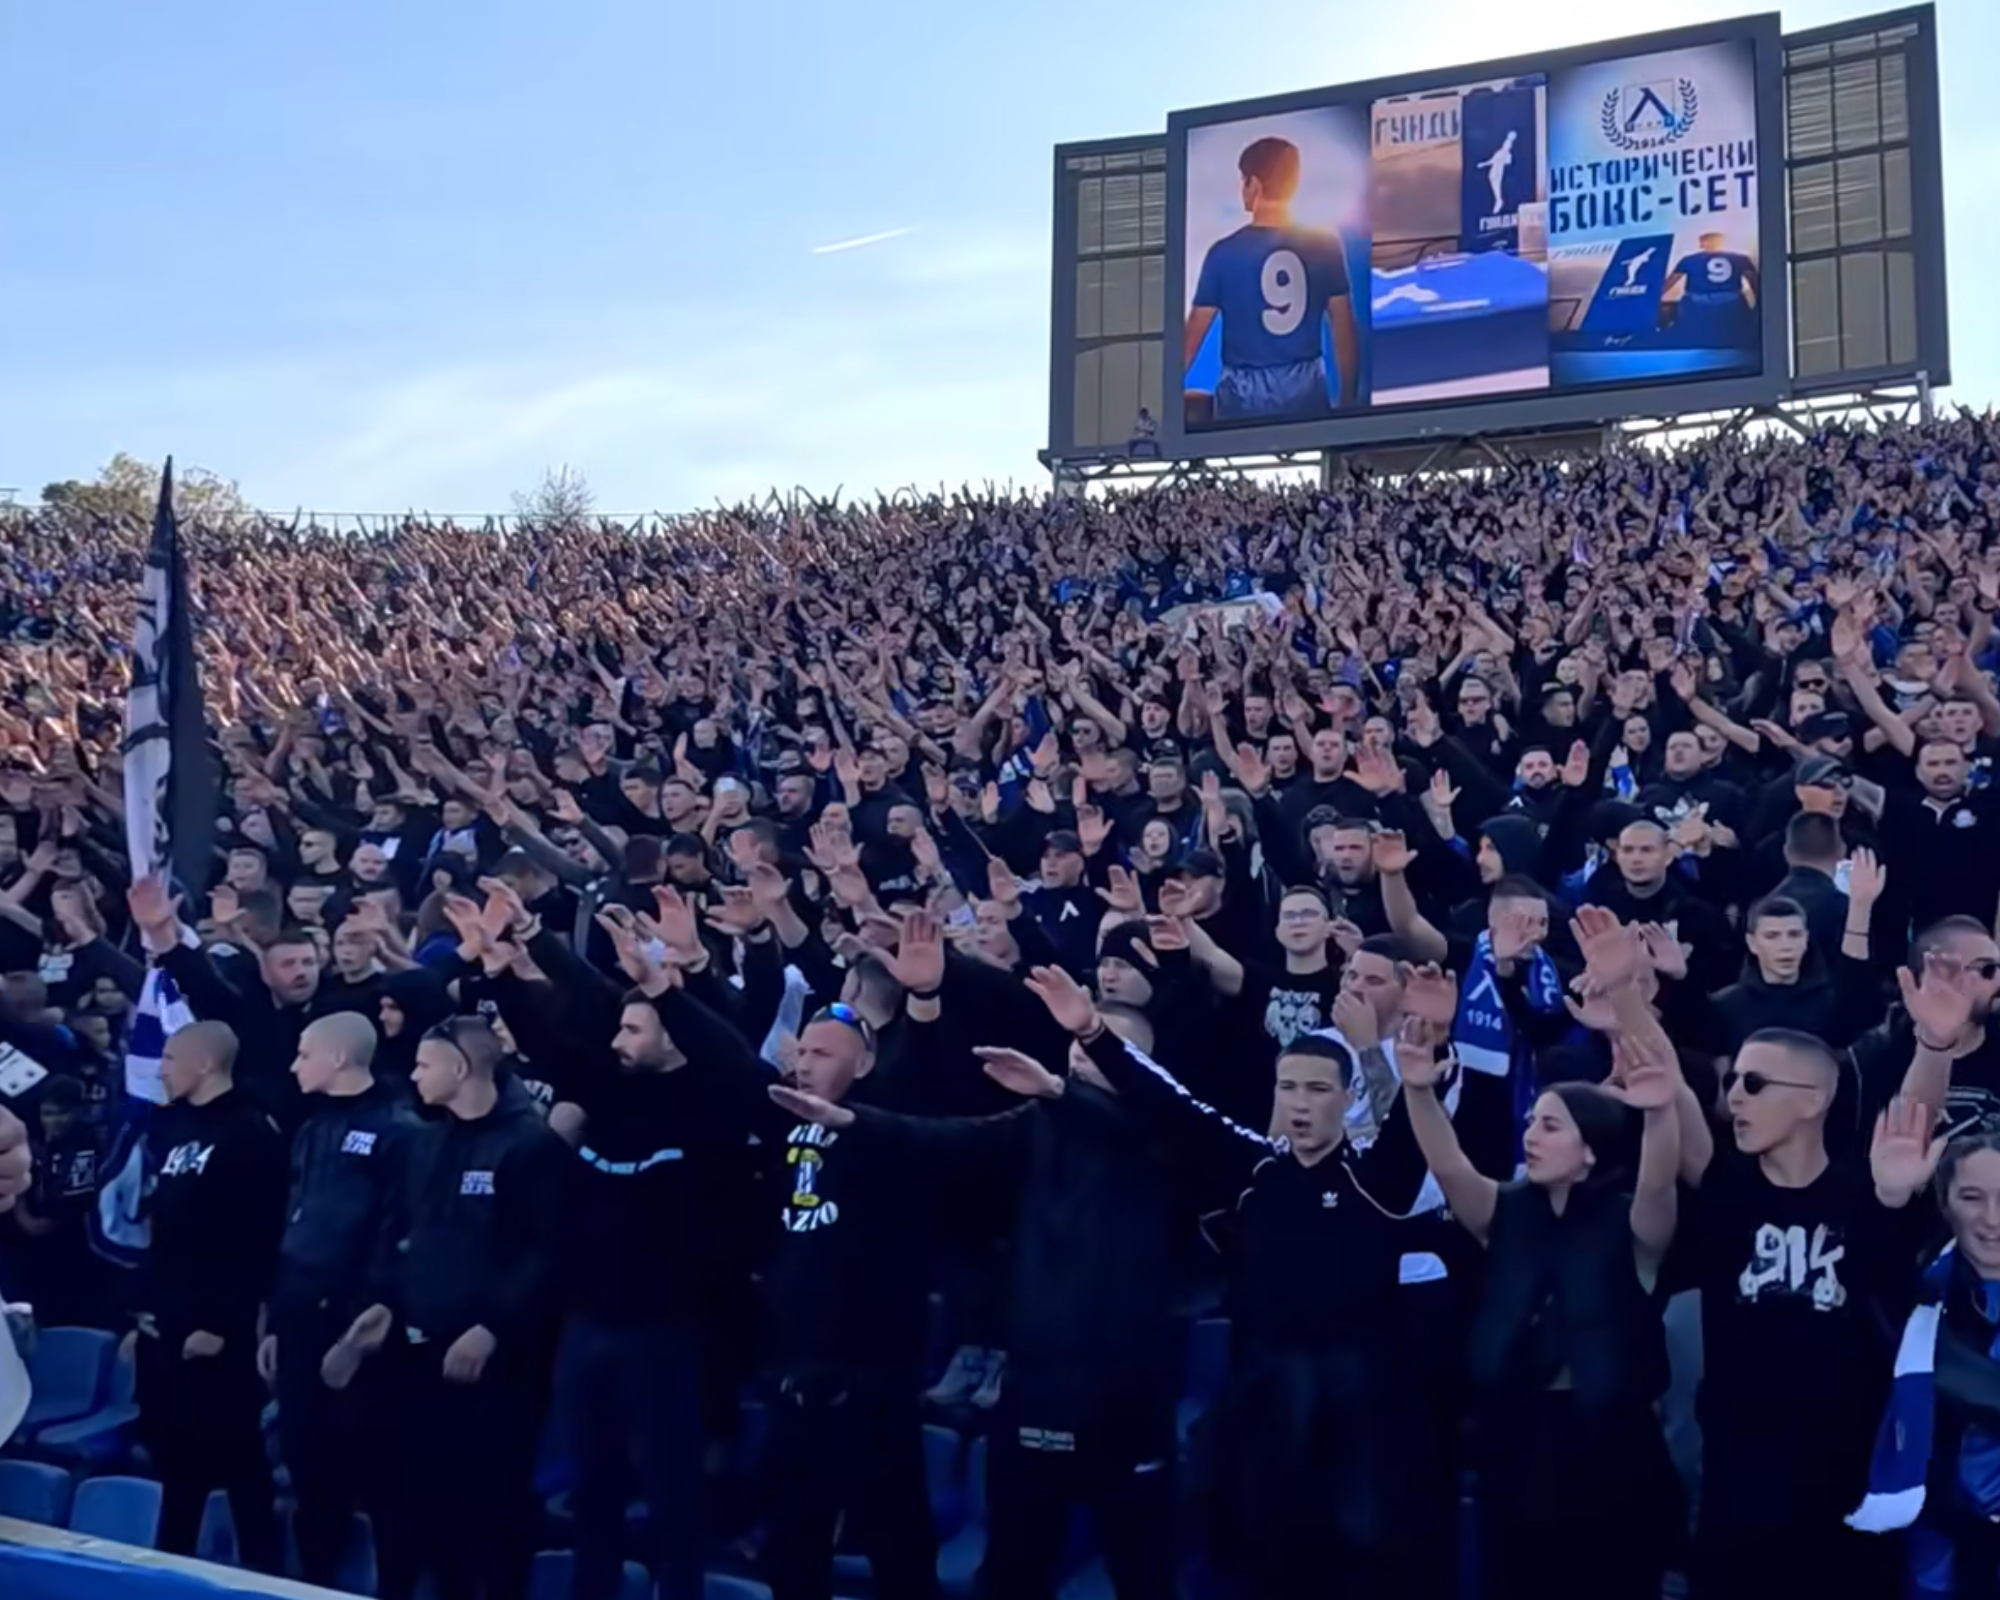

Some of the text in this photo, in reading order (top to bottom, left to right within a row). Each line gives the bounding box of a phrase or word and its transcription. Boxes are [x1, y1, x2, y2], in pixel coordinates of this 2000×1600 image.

[1634, 137, 1666, 151] 1914
[1551, 138, 1754, 194] ИСТОРИЧЕСКИ
[1550, 170, 1755, 234] БОКС-СЕТ
[1706, 257, 1733, 283] 9
[1260, 249, 1308, 336] 9
[1466, 1009, 1503, 1031] 1914
